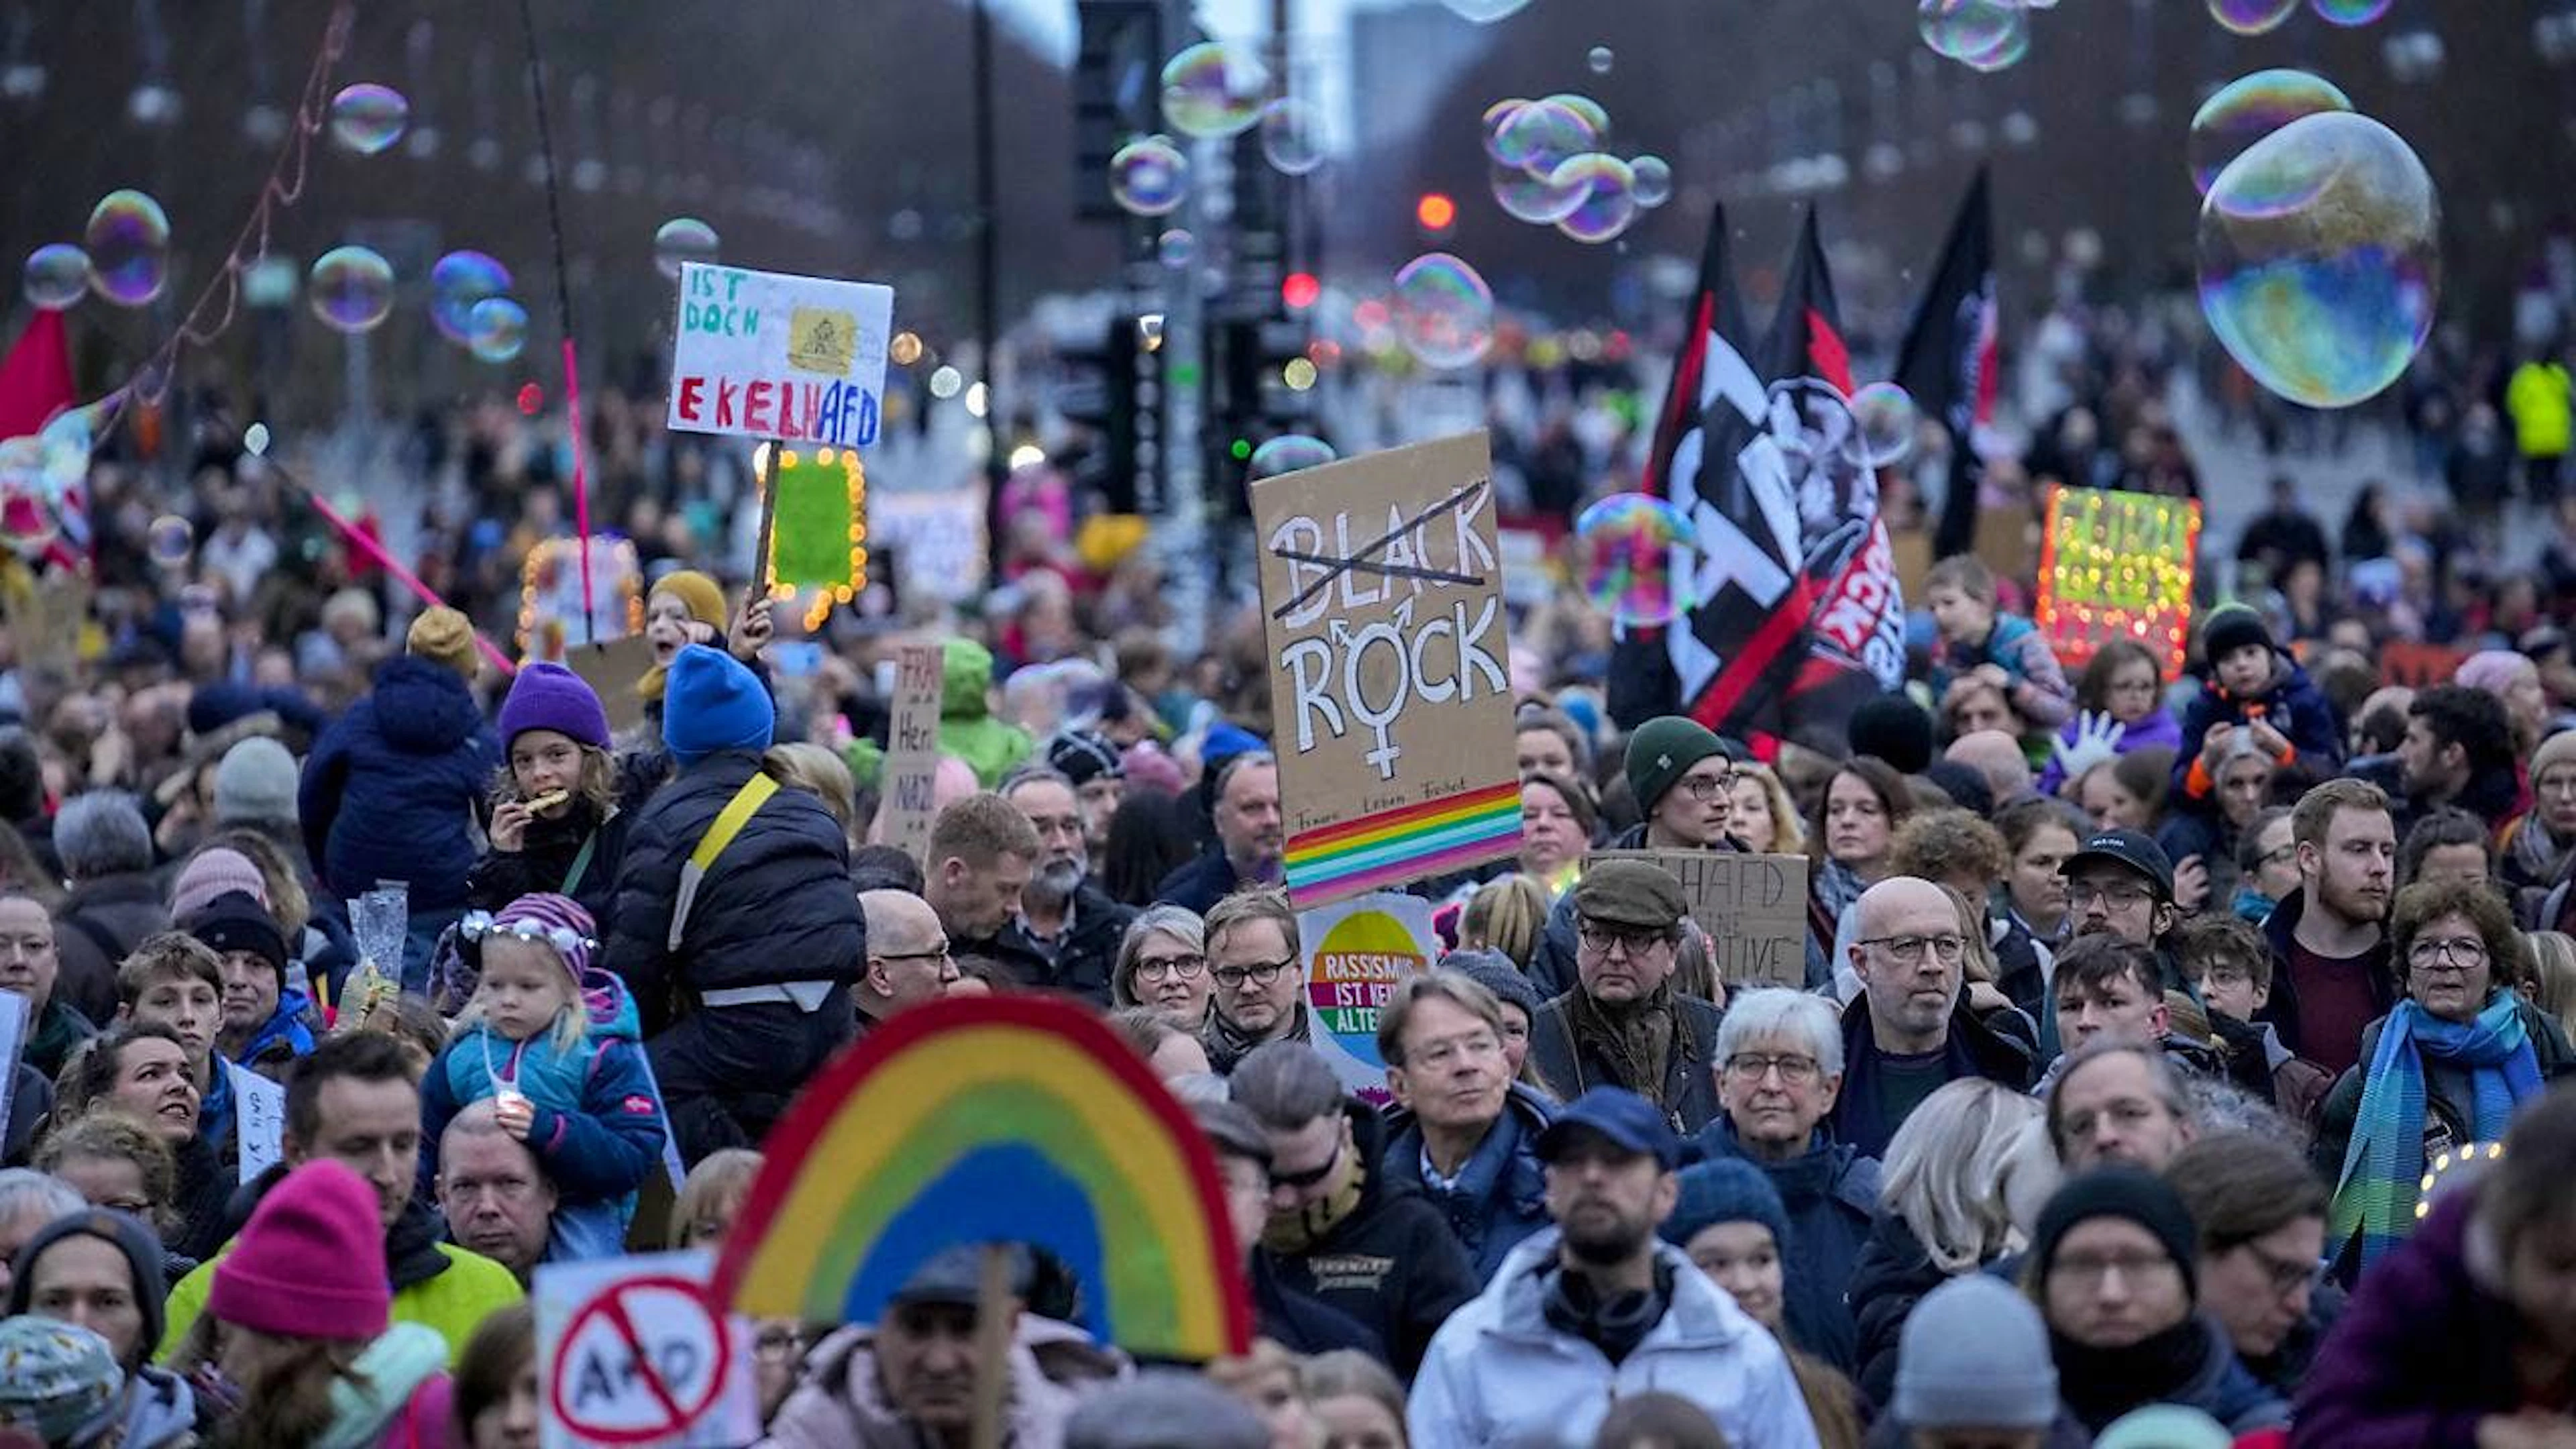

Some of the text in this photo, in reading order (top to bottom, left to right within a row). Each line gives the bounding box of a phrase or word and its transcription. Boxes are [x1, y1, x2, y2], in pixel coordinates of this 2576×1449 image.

[691, 269, 747, 301] IST
[684, 301, 759, 335] DOCH
[1268, 479, 1495, 629] BLACK
[1281, 594, 1508, 754] ROCK
[1659, 857, 1784, 908] HAFD
[1335, 982, 1364, 1006] IST
